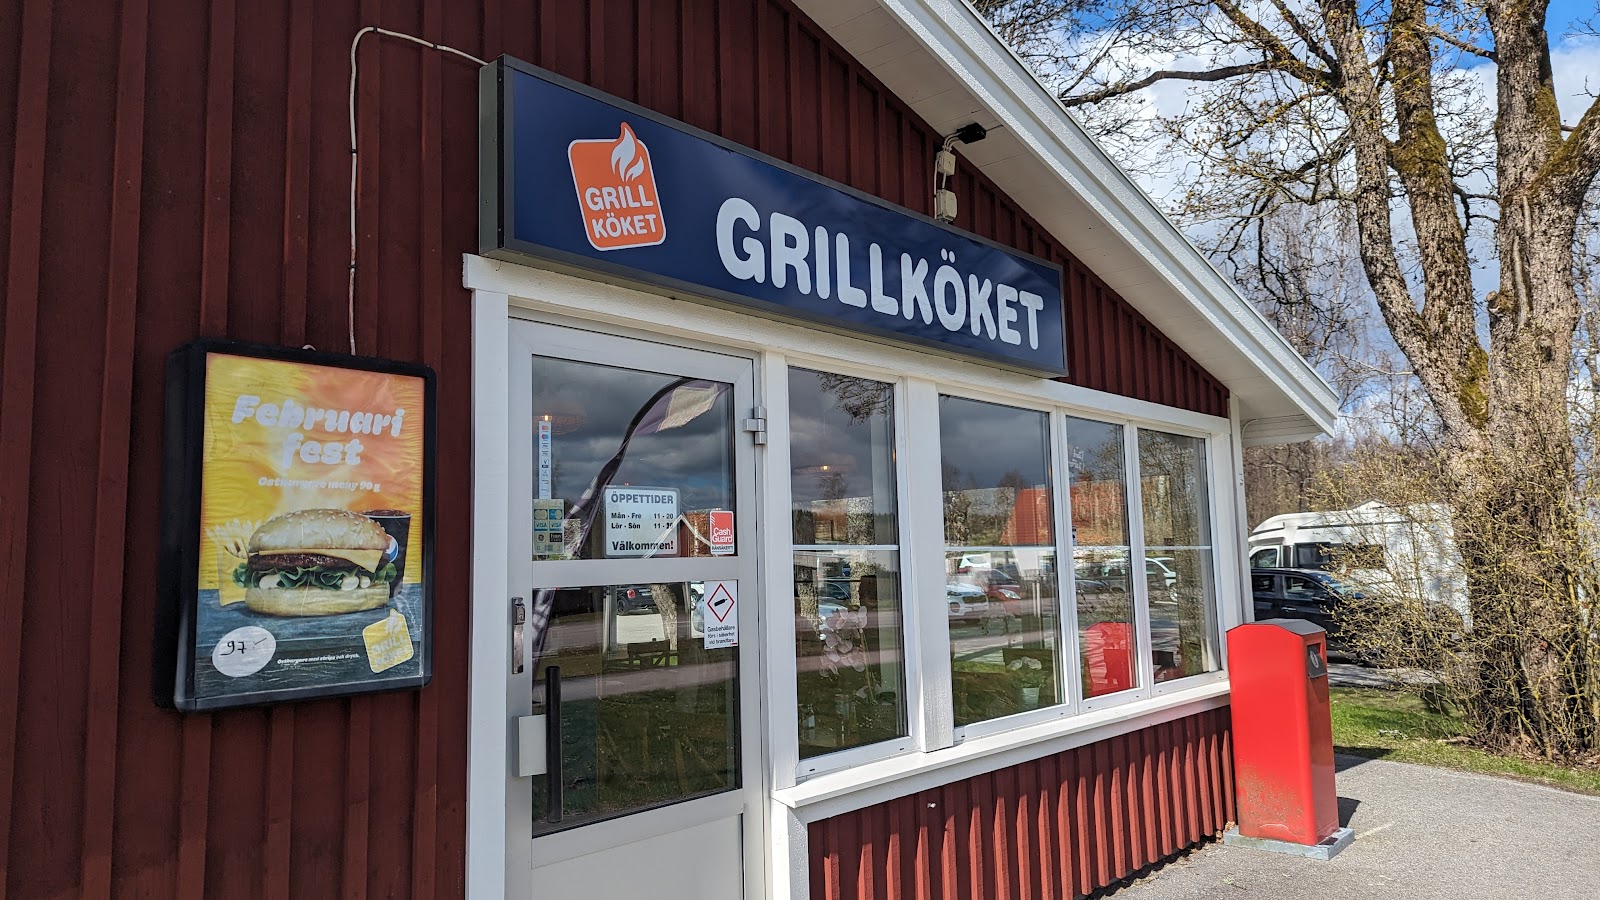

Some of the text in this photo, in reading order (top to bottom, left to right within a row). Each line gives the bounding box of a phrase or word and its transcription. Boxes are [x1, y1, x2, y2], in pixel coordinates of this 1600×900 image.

[585, 184, 654, 211] GRILL
[591, 212, 657, 239] KÖKET
[715, 197, 1045, 350] GRILLKÖKET
[231, 395, 406, 437] Februari
[282, 432, 364, 469] fest
[327, 480, 359, 492] meny
[359, 480, 373, 491] 90
[610, 490, 674, 505] ÖPPETTIDER
[611, 511, 626, 519] Mån
[666, 512, 674, 520] 20
[712, 535, 733, 543] Guard
[713, 527, 731, 536] Cash
[612, 540, 674, 551] Välkommen!
